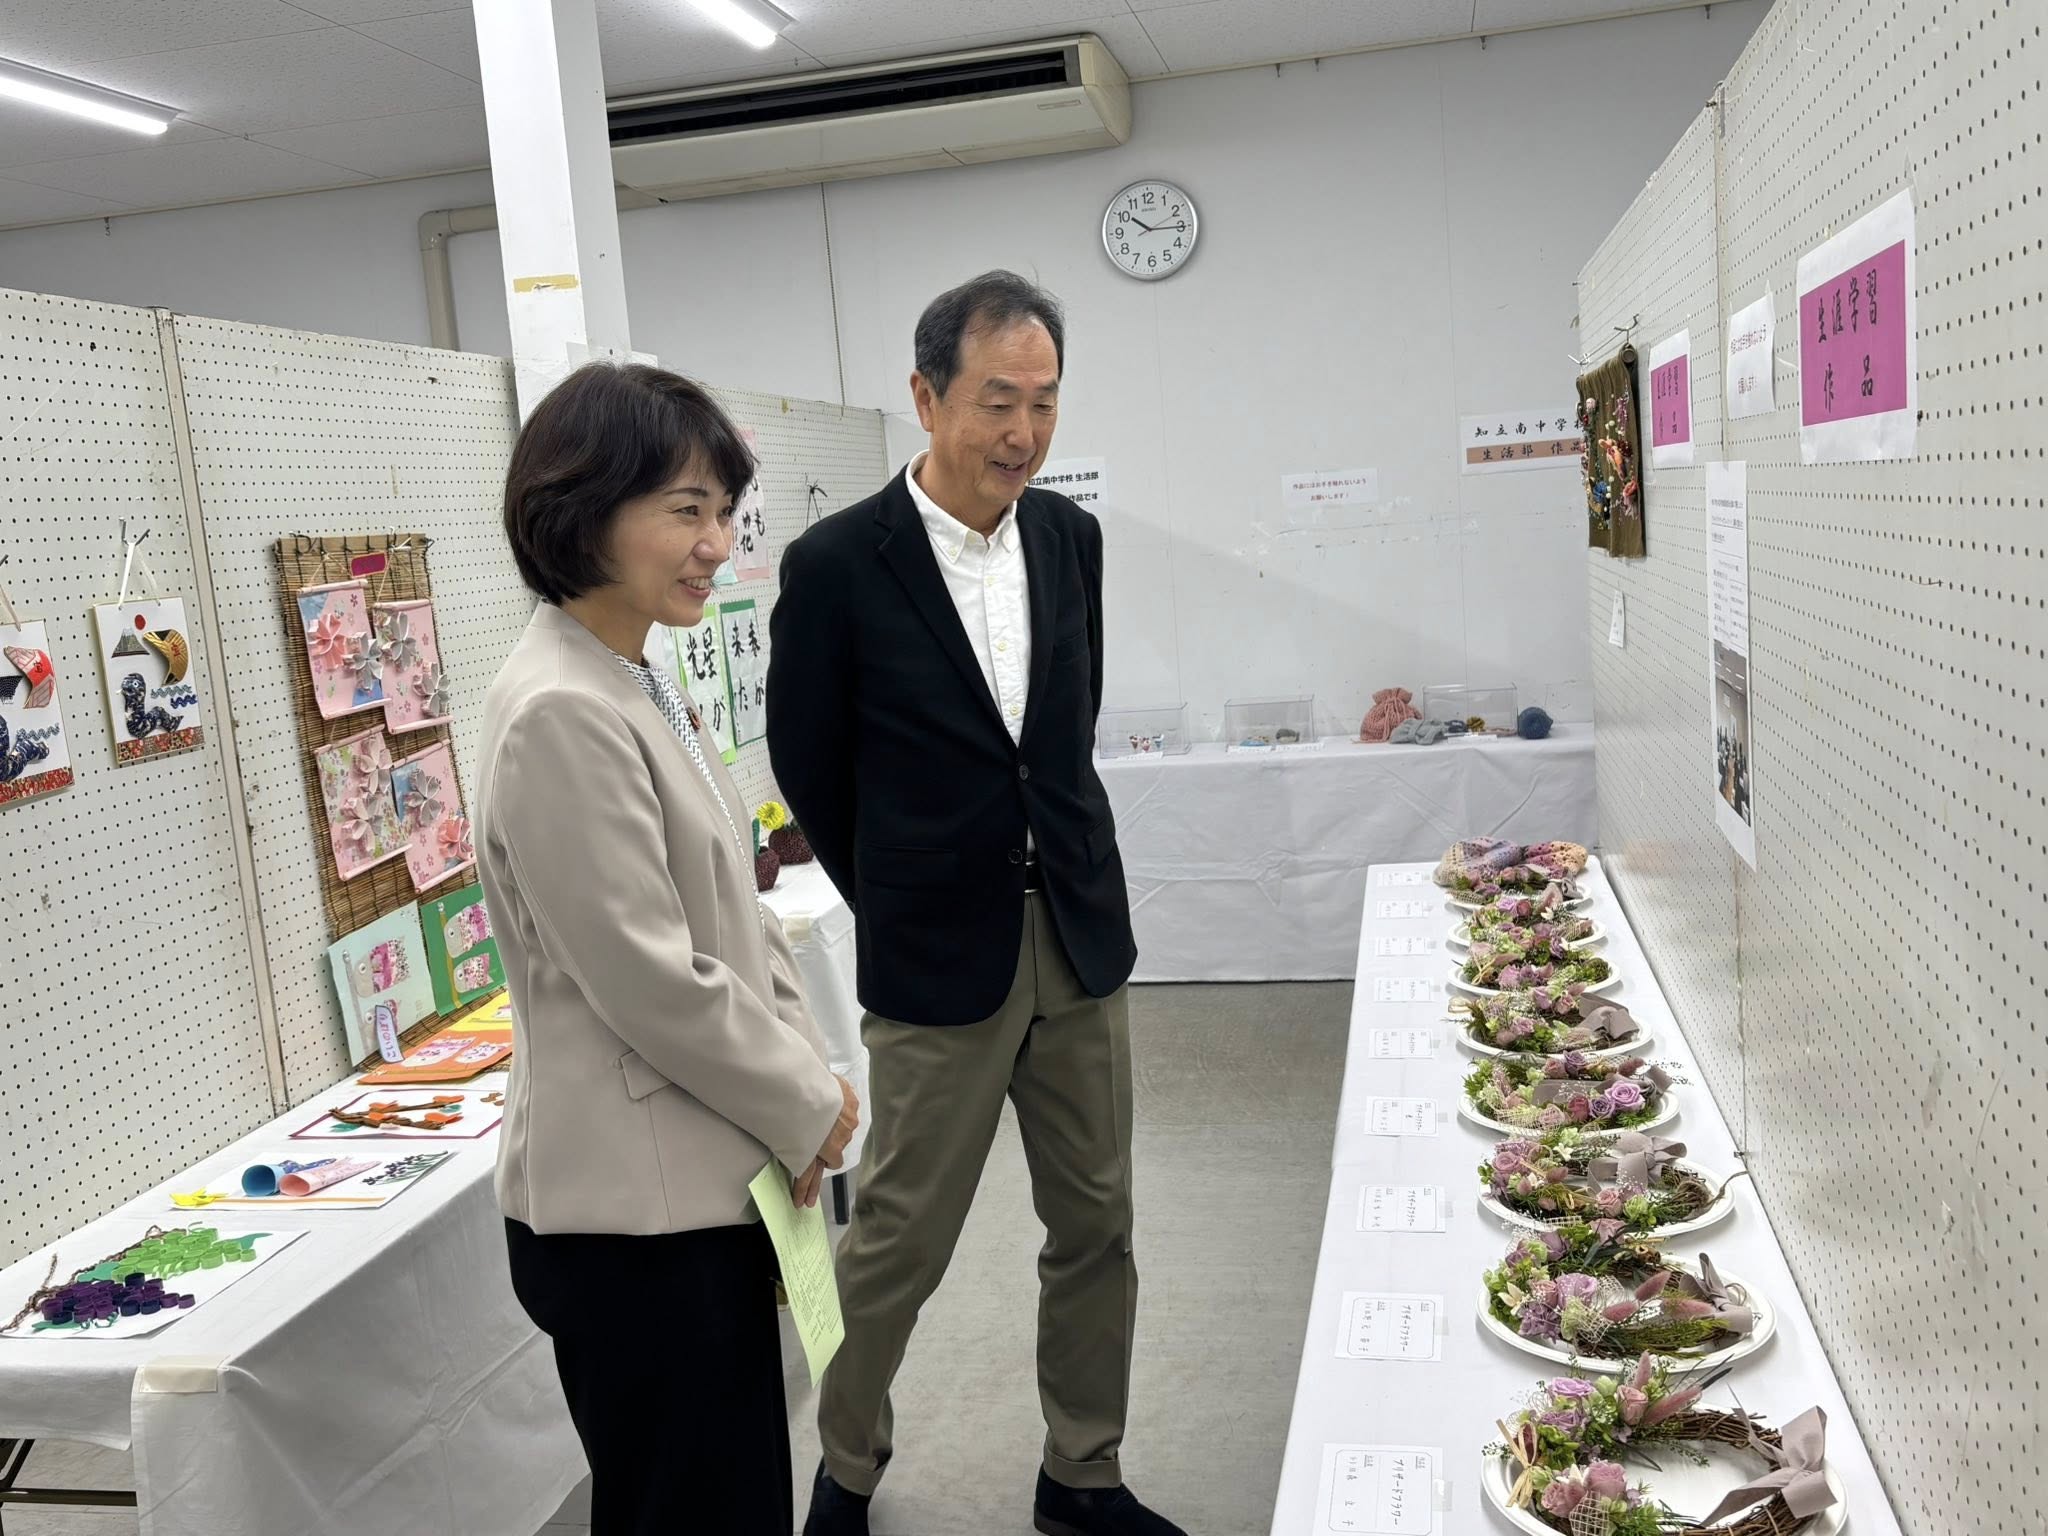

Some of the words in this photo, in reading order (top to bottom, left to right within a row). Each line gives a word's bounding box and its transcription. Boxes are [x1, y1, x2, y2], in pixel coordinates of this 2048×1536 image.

[1128, 198, 1137, 210] 11
[1141, 192, 1154, 204] 12
[1161, 194, 1166, 206] 1
[1118, 211, 1130, 223] 10
[1171, 205, 1180, 217] 2
[1176, 220, 1185, 232] 3
[1115, 227, 1124, 239] 9
[1173, 237, 1182, 248] 4
[1121, 243, 1130, 255] 8
[1132, 253, 1141, 264] 7
[1147, 255, 1157, 267] 6
[1163, 250, 1172, 261] 5
[1818, 269, 1877, 343] 生涯学習
[1483, 444, 1534, 461] 生活部
[1075, 471, 1099, 482] 生活部
[379, 1014, 396, 1058] こいのぼり
